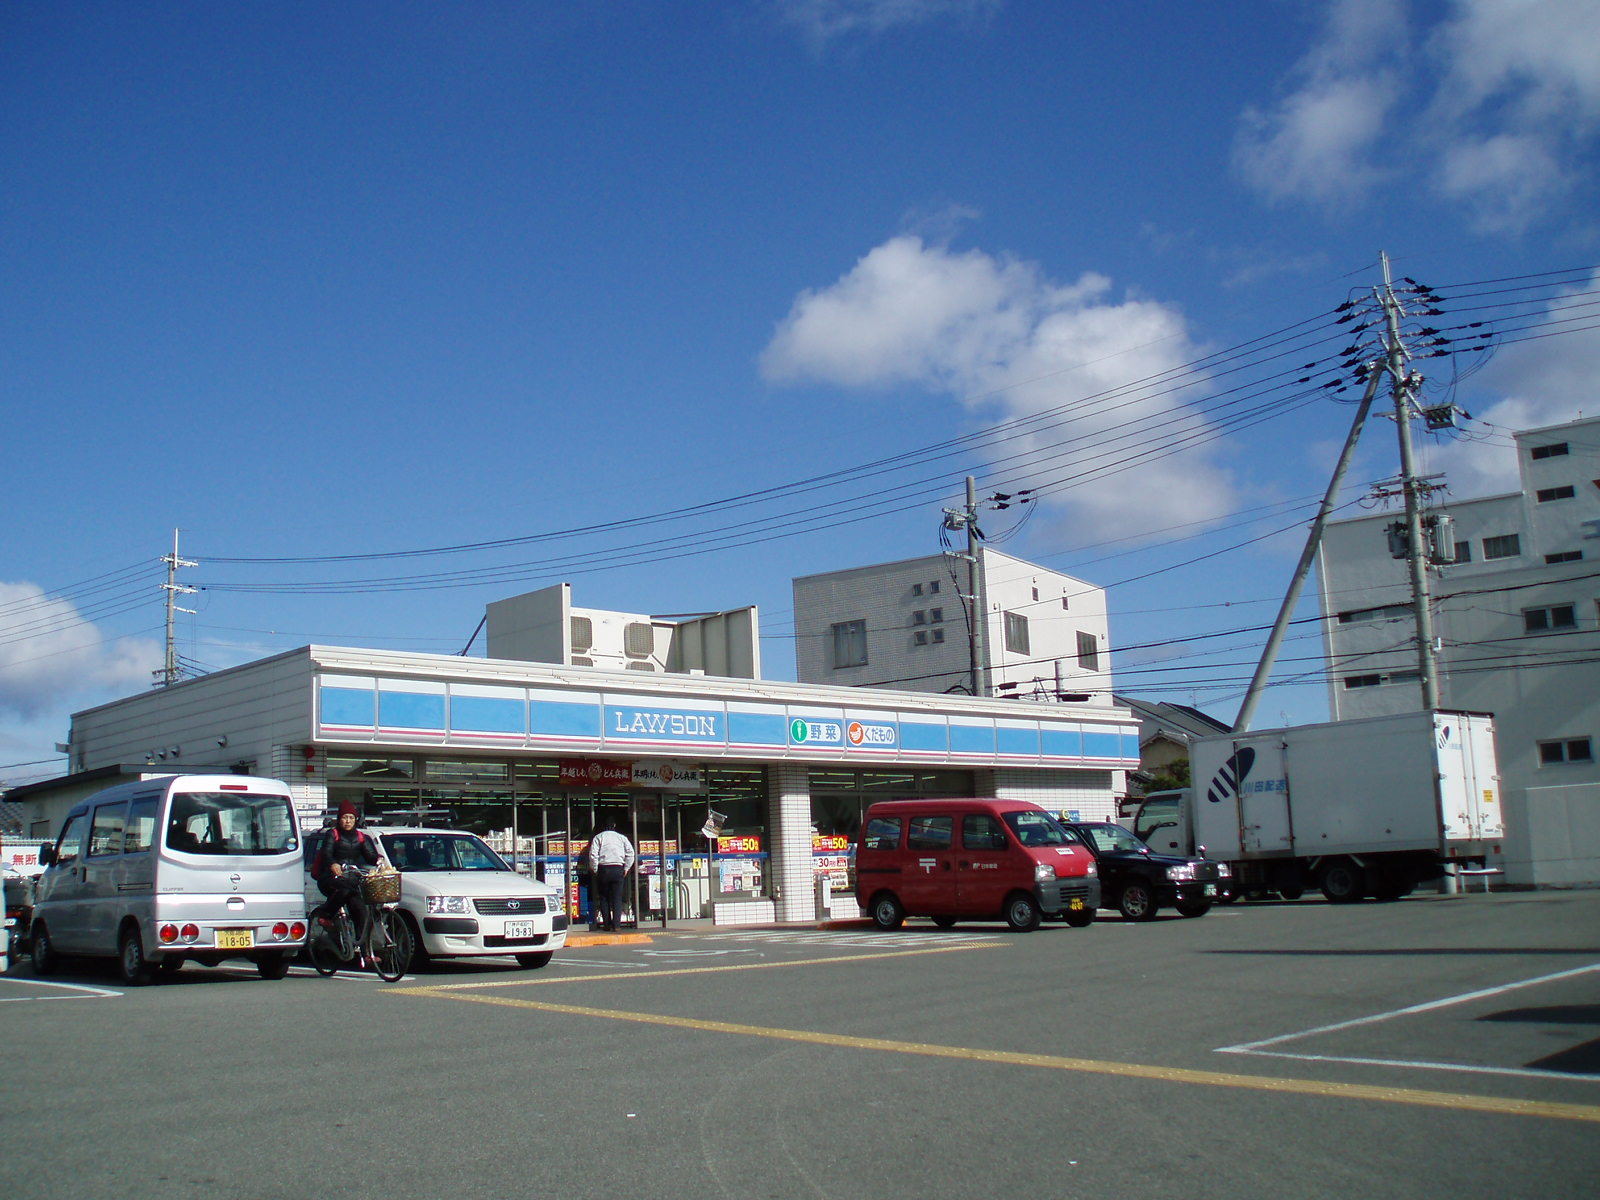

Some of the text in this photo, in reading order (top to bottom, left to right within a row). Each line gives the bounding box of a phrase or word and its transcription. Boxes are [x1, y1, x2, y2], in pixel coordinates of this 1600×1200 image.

[615, 711, 716, 736] LAWSON
[810, 724, 837, 740] 野菜
[864, 727, 893, 743] くだもの
[13, 853, 37, 866] 無断
[225, 936, 251, 947] 18-05
